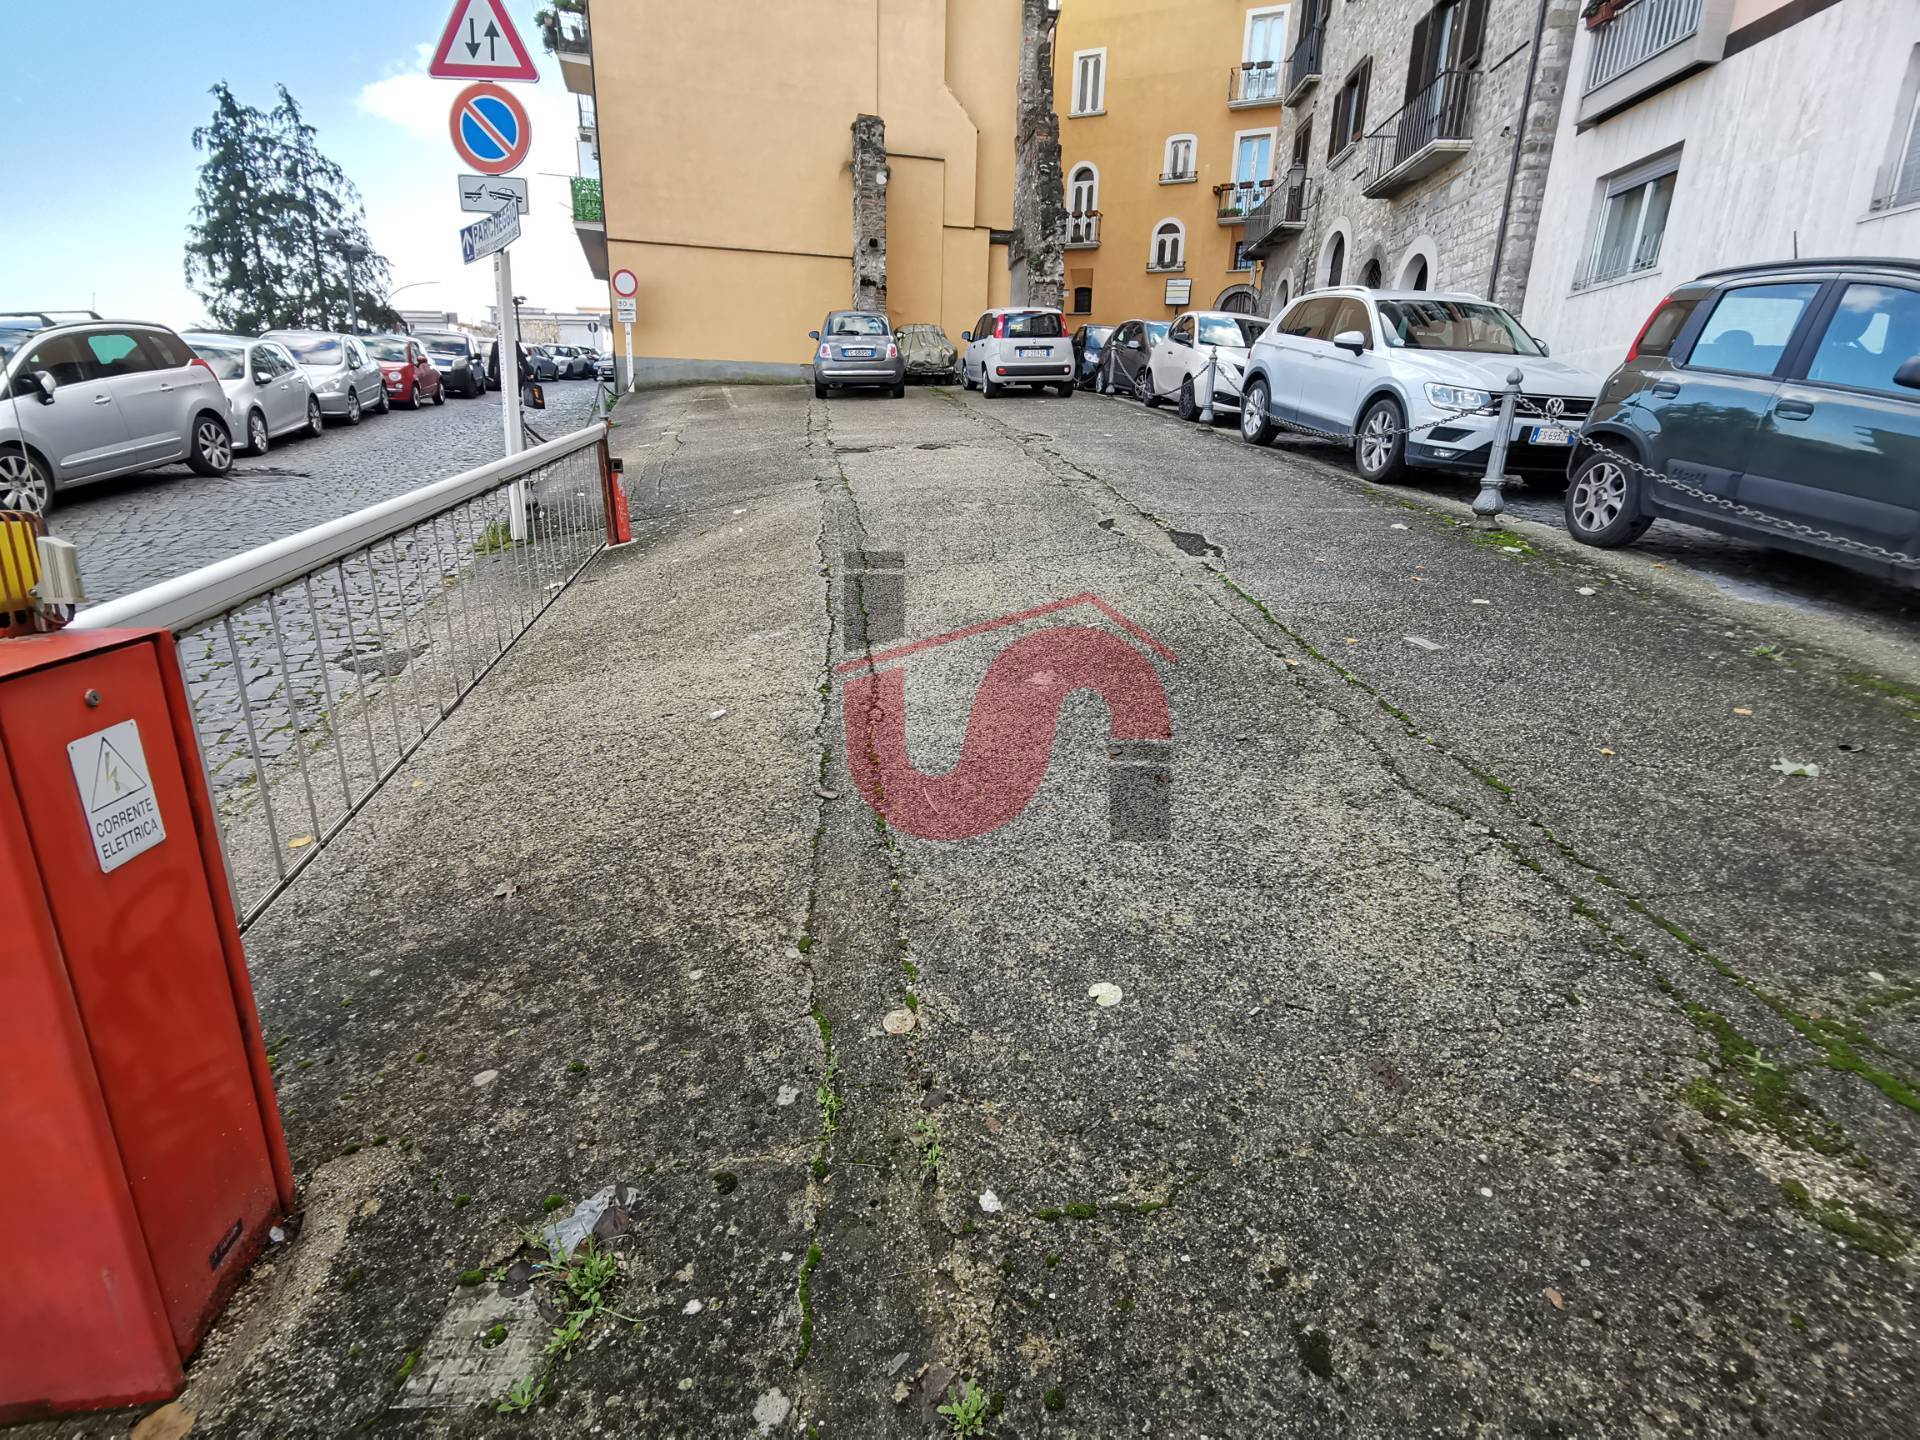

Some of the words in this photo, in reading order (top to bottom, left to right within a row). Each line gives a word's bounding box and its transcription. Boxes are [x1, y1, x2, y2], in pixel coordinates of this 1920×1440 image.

[473, 201, 517, 244] PARCHEGGIO
[96, 797, 153, 838] CORRENTE
[101, 818, 159, 859] ELETTRICA
